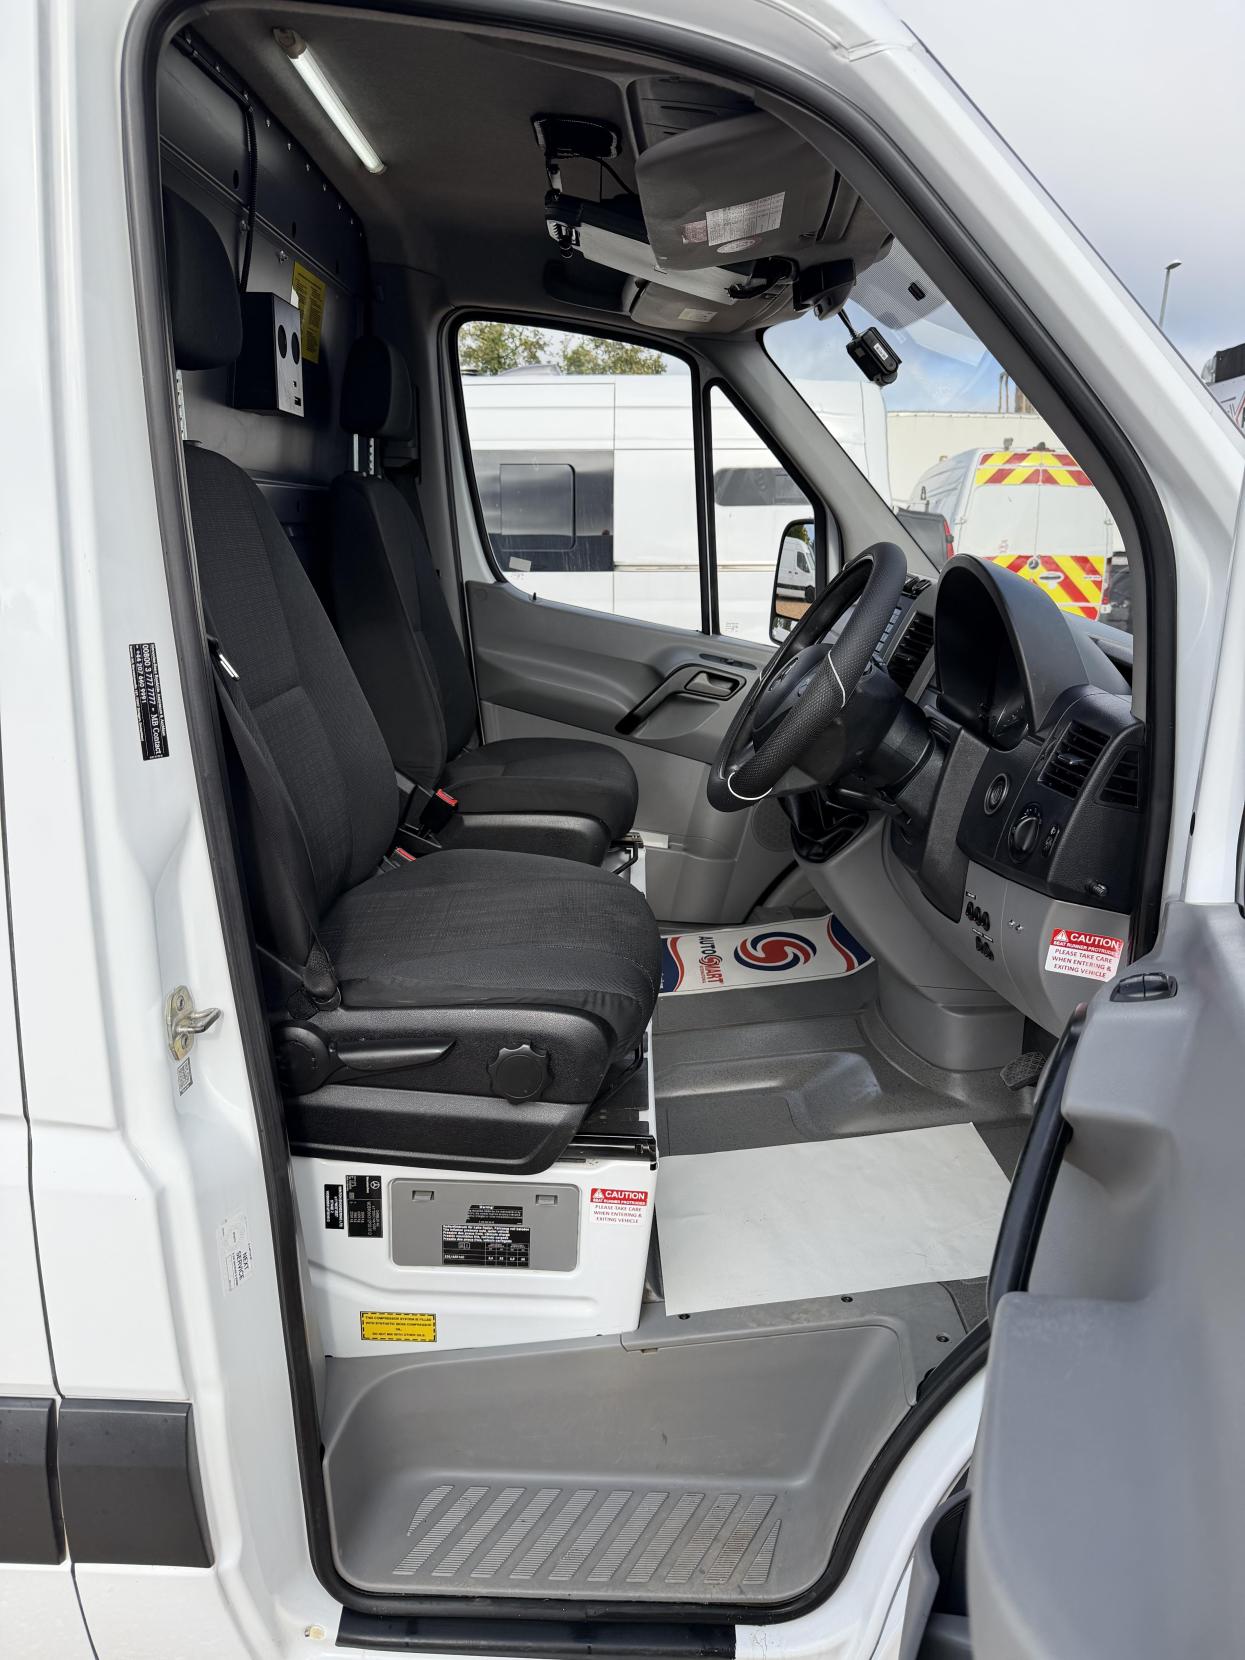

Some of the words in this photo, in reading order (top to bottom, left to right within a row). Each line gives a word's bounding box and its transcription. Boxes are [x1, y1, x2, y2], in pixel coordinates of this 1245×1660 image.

[142, 644, 151, 666] 00800
[146, 673, 154, 686] 777
[151, 714, 158, 726] MB
[152, 727, 162, 755] Contact
[1070, 933, 1120, 950] CAUTION
[1052, 956, 1072, 964] WHEN
[1072, 958, 1105, 971] ENTERING
[1054, 948, 1078, 957] PLEASE
[1079, 952, 1094, 960] TAKE
[1096, 955, 1113, 964] CARE
[1054, 963, 1079, 974] EXITING
[1080, 968, 1107, 978] VEHICLE
[605, 1190, 645, 1200] CAUTION
